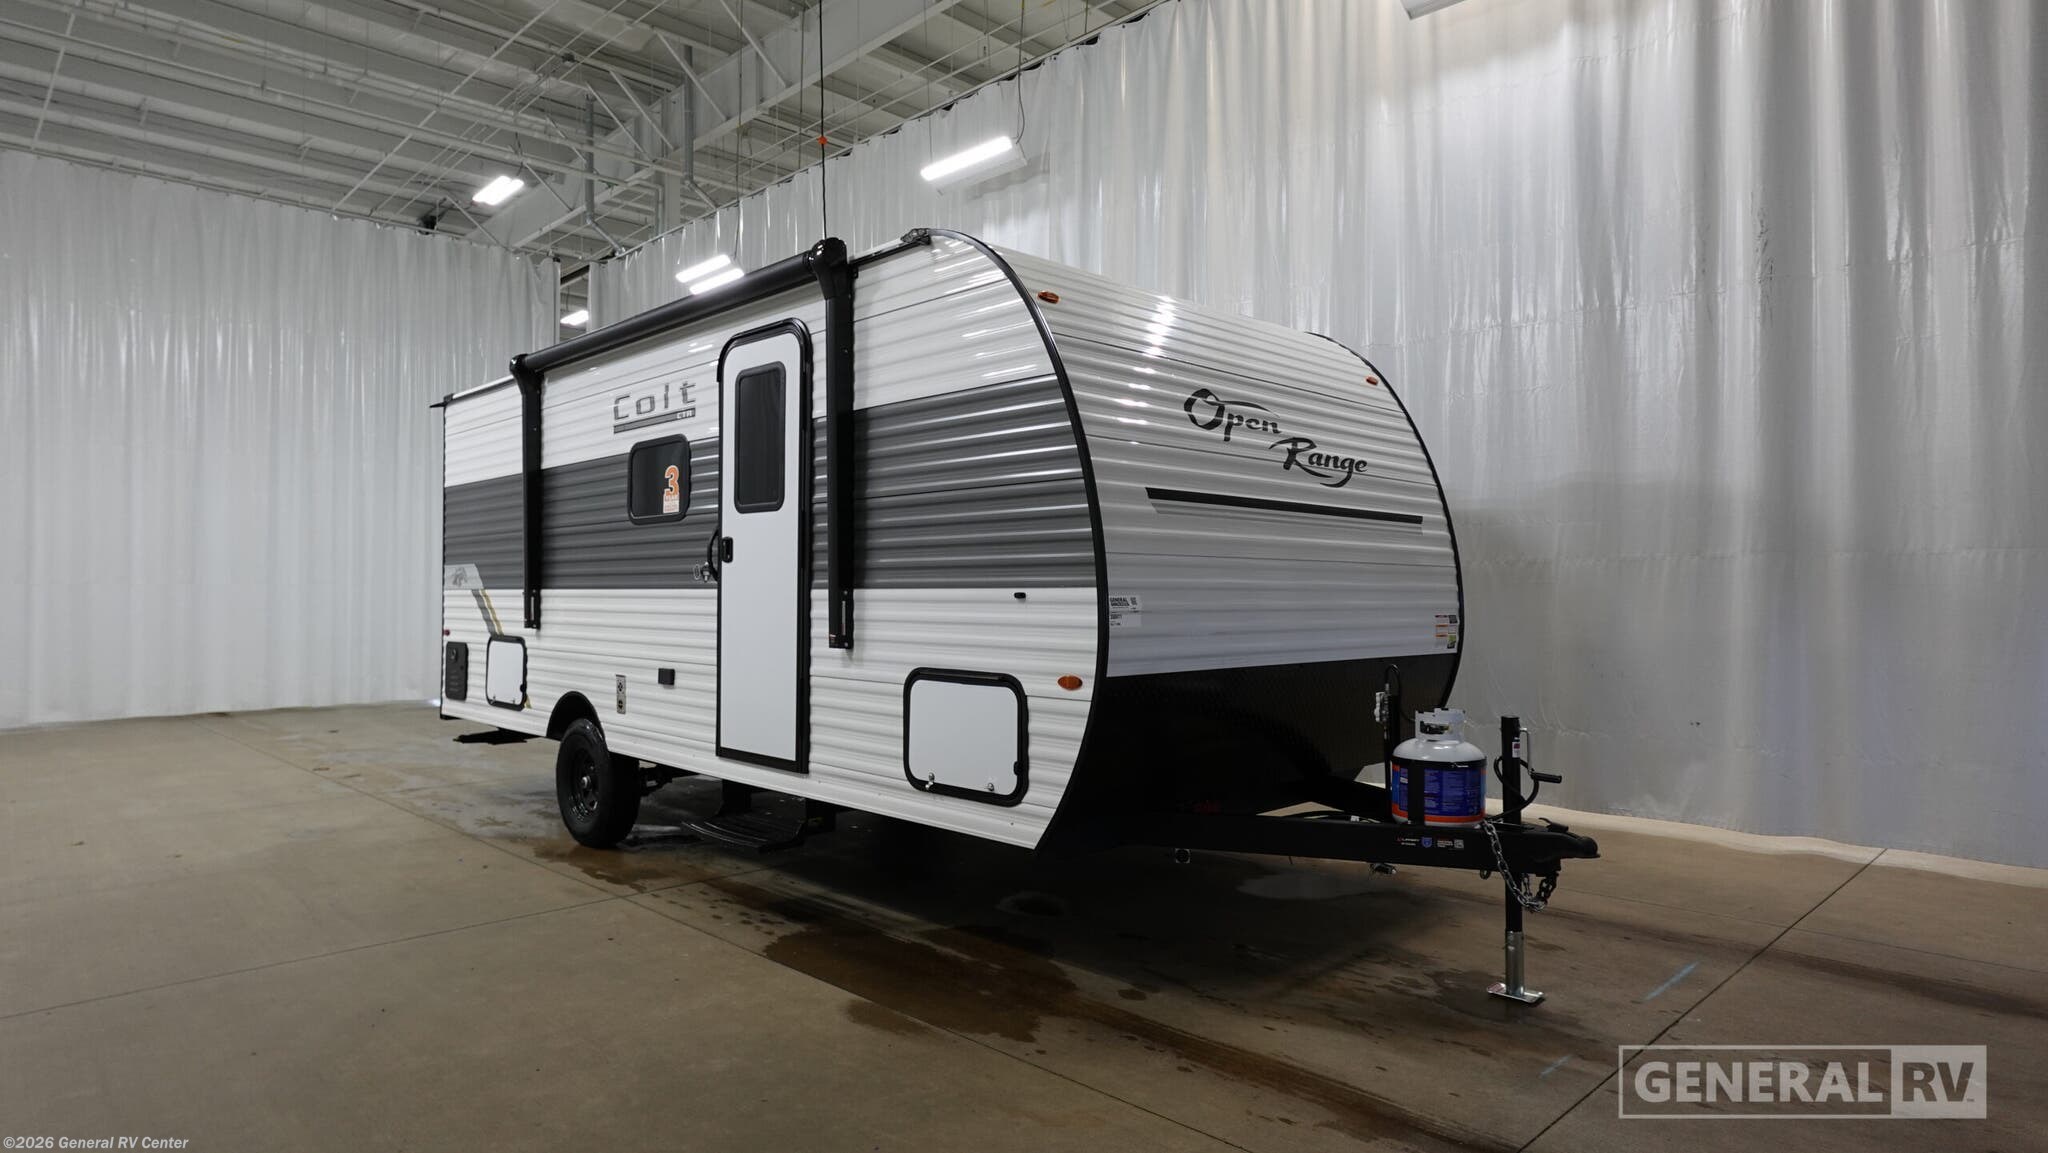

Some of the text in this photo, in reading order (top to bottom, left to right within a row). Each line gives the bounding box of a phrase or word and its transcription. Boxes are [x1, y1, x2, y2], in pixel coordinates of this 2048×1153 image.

[613, 381, 696, 420] Colt
[1183, 388, 1282, 442] Open
[664, 465, 680, 497] 3
[1268, 437, 1368, 488] Range
